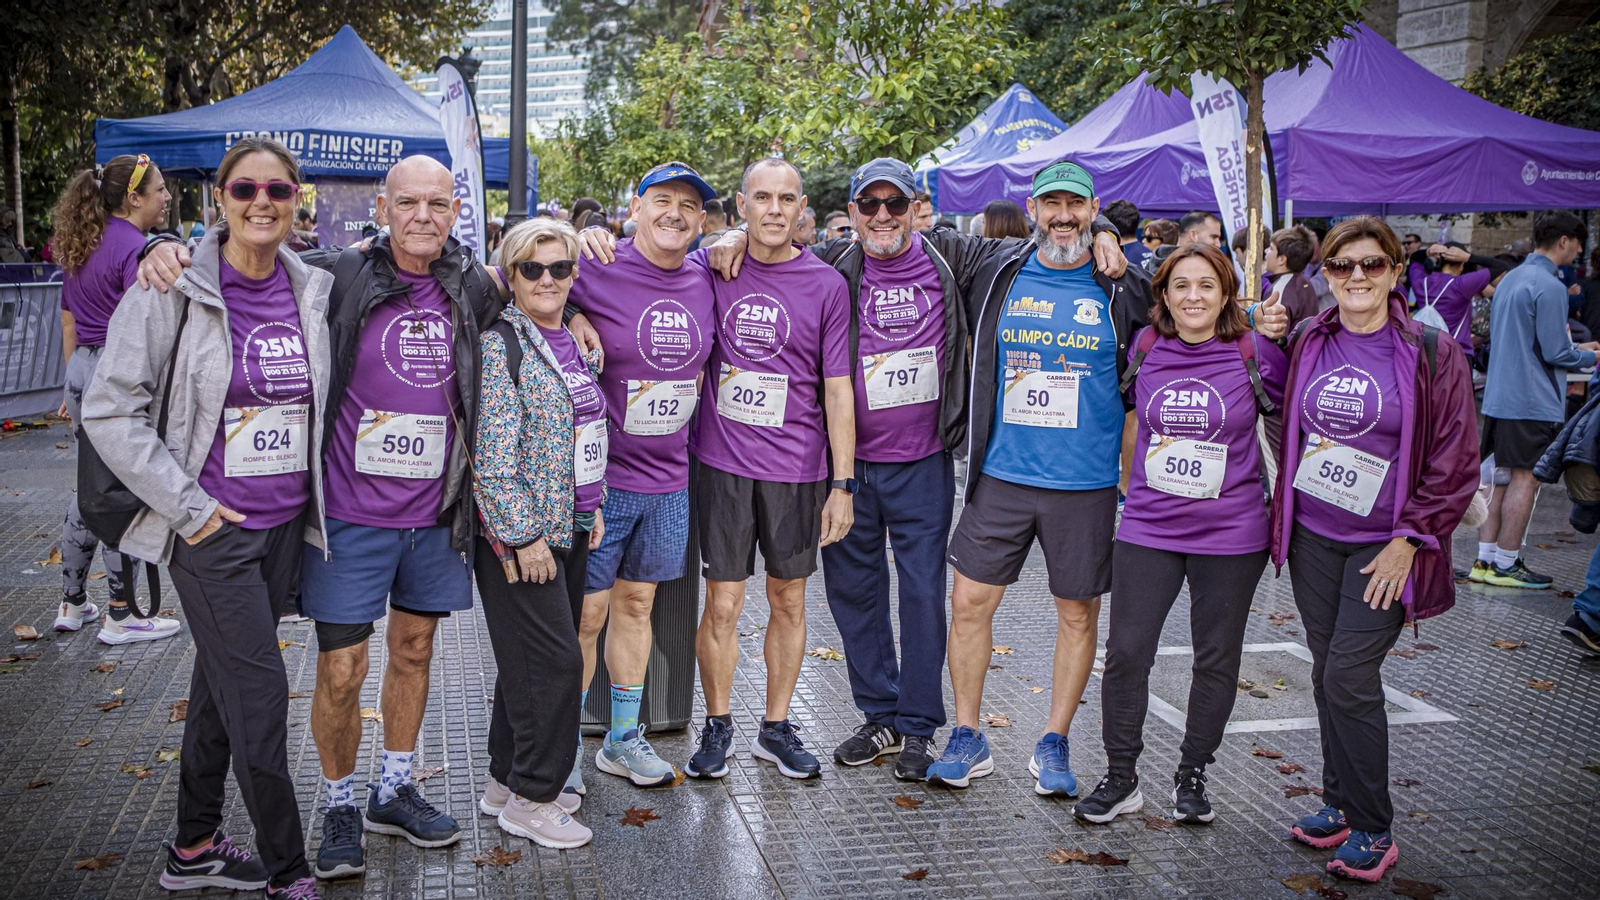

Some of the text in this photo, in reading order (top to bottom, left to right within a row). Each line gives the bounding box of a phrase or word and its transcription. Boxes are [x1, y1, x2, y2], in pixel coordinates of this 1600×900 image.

[308, 134, 403, 163] FINISHER
[296, 159, 353, 169] ORGANIZACIÓN
[367, 163, 392, 171] EVENT
[1540, 169, 1600, 181] Ayuntamiento de C
[874, 287, 914, 305] 25N
[651, 310, 688, 328] 25N
[738, 304, 778, 323] 25N
[400, 320, 446, 339] 25N
[254, 336, 304, 358] 25N
[1001, 329, 1100, 350] OLIMPO CÁDIZ
[396, 374, 413, 386] CONTRA
[422, 380, 445, 388] VIOLENCA
[885, 368, 918, 387] 797
[1323, 376, 1369, 395] 25N
[732, 386, 766, 407] 202
[1027, 390, 1049, 407] 50
[1163, 390, 1209, 407] 25N
[648, 399, 679, 416] 152
[254, 428, 291, 452] 624
[382, 434, 424, 456] 590
[1194, 444, 1224, 452] CARRERA
[584, 441, 602, 462] 591
[1165, 456, 1202, 478] 508
[1354, 454, 1385, 470] CARRERA
[1158, 476, 1190, 486] TOLERANCIA
[1319, 460, 1358, 488] 589
[1307, 477, 1325, 488] ROMPE
[1333, 487, 1359, 501] SILENCIO
